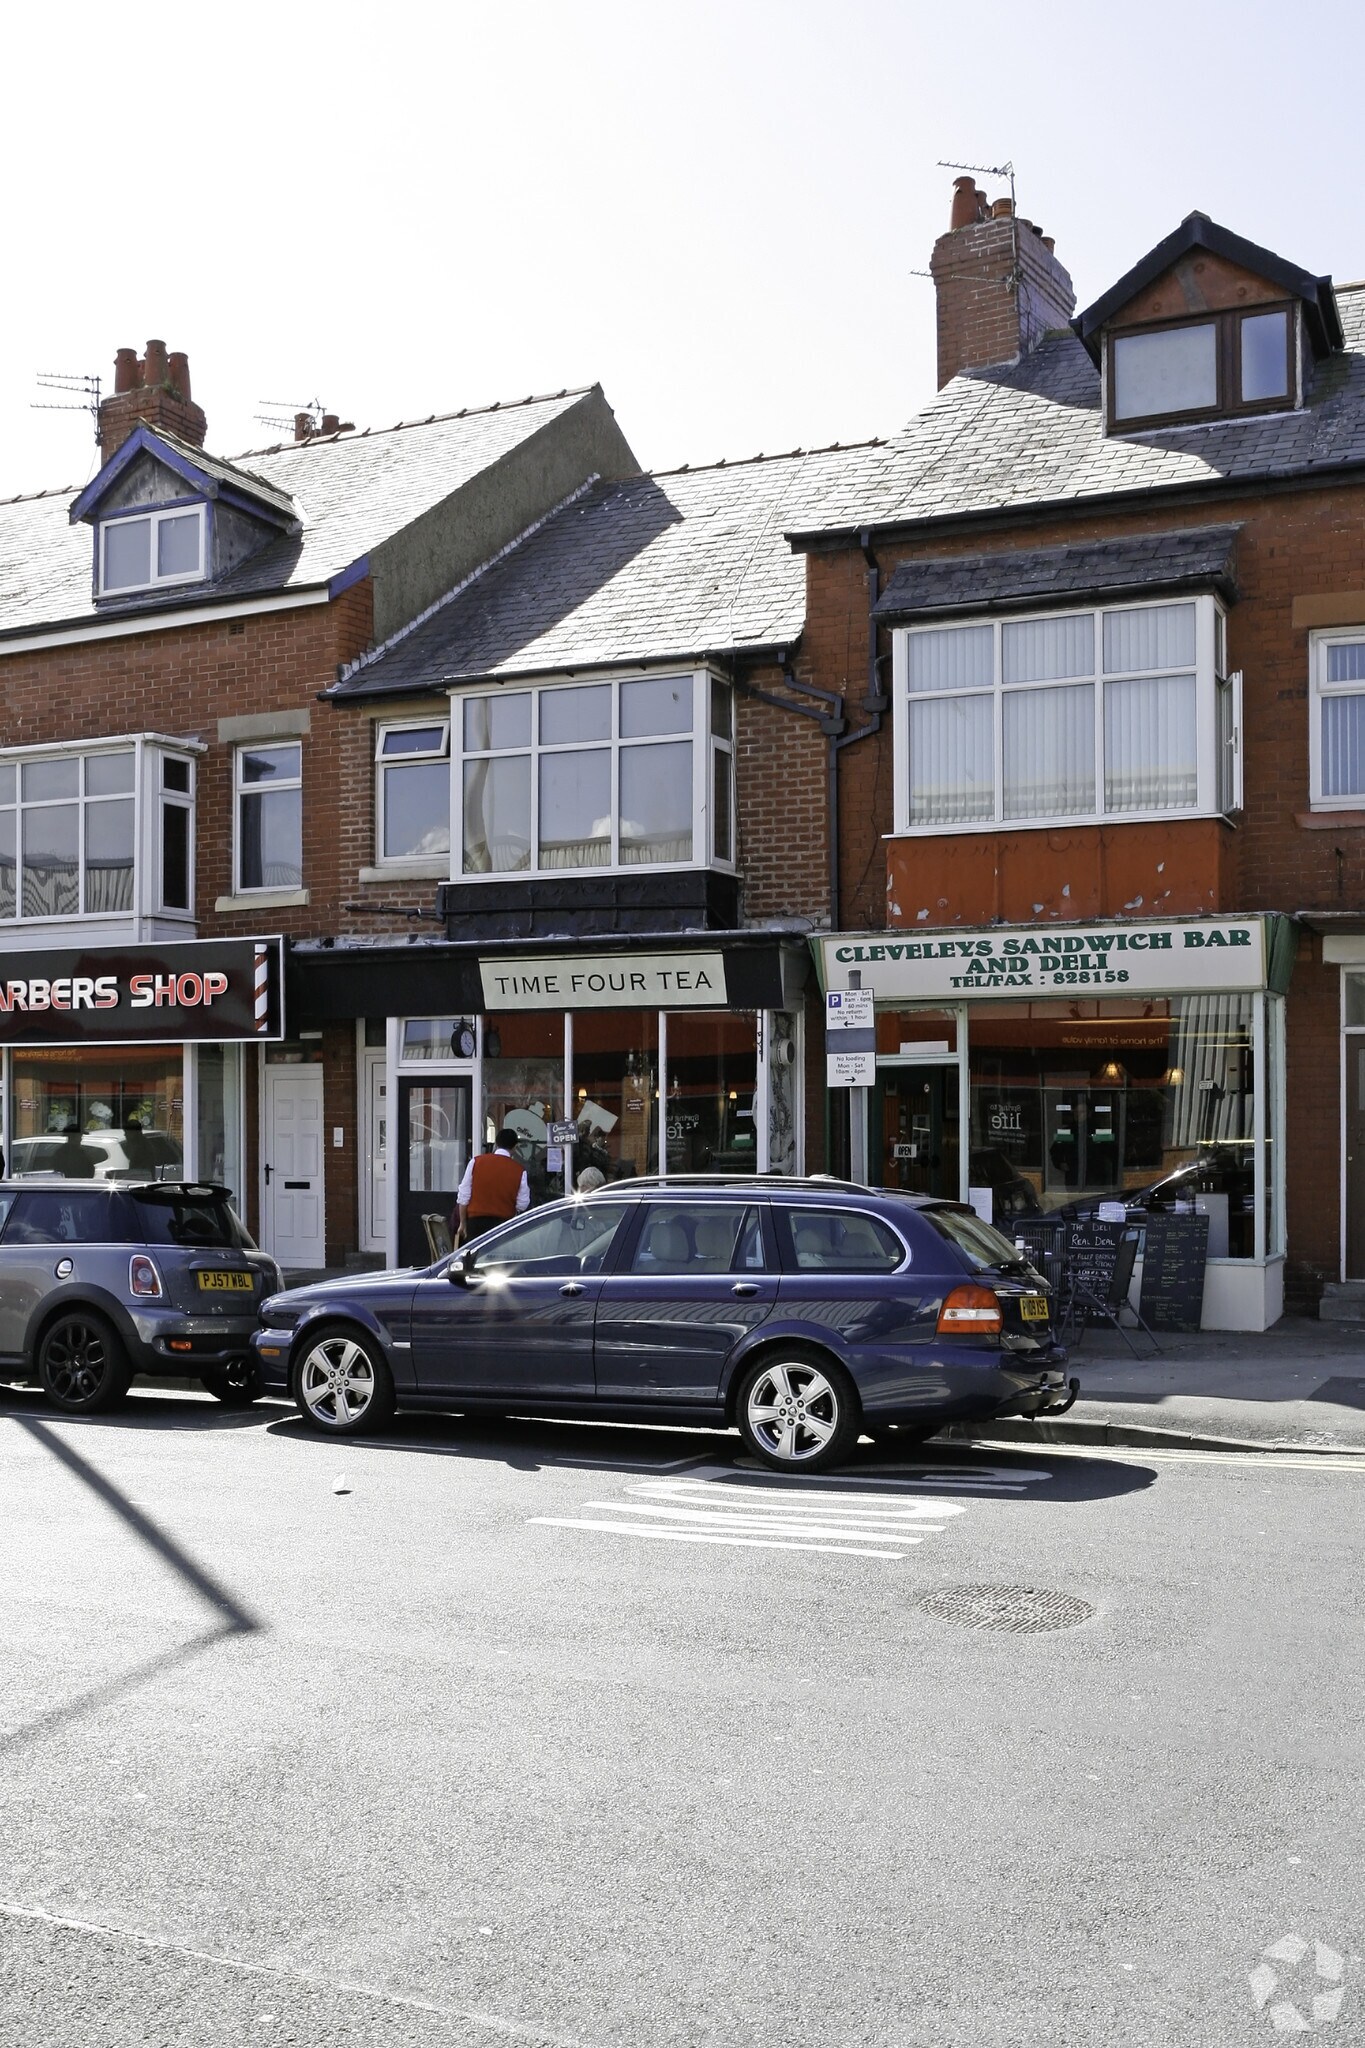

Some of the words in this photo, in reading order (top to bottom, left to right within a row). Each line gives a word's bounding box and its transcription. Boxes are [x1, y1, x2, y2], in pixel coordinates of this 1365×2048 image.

[835, 939, 994, 963] CLEVELEYS
[1002, 932, 1173, 956] SANDWICH
[1183, 929, 1252, 948] BAR
[965, 957, 1030, 974] AND
[1038, 953, 1108, 972] DELI
[494, 975, 560, 994] TIME
[570, 973, 647, 992] FOUR
[656, 970, 713, 990] TEA
[950, 973, 1034, 988] TEL/FAX
[1052, 969, 1130, 985] 828158
[129, 972, 229, 1008] SHOP
[831, 996, 839, 1006] P
[553, 1133, 576, 1143] OPEN
[898, 1146, 911, 1156] OPEN
[1070, 1223, 1084, 1232] THE
[1092, 1222, 1111, 1232] DELI
[1071, 1233, 1090, 1246] REAL
[1095, 1236, 1116, 1246] DEAL
[203, 1273, 229, 1287] PJ57
[231, 1274, 250, 1288] WBL
